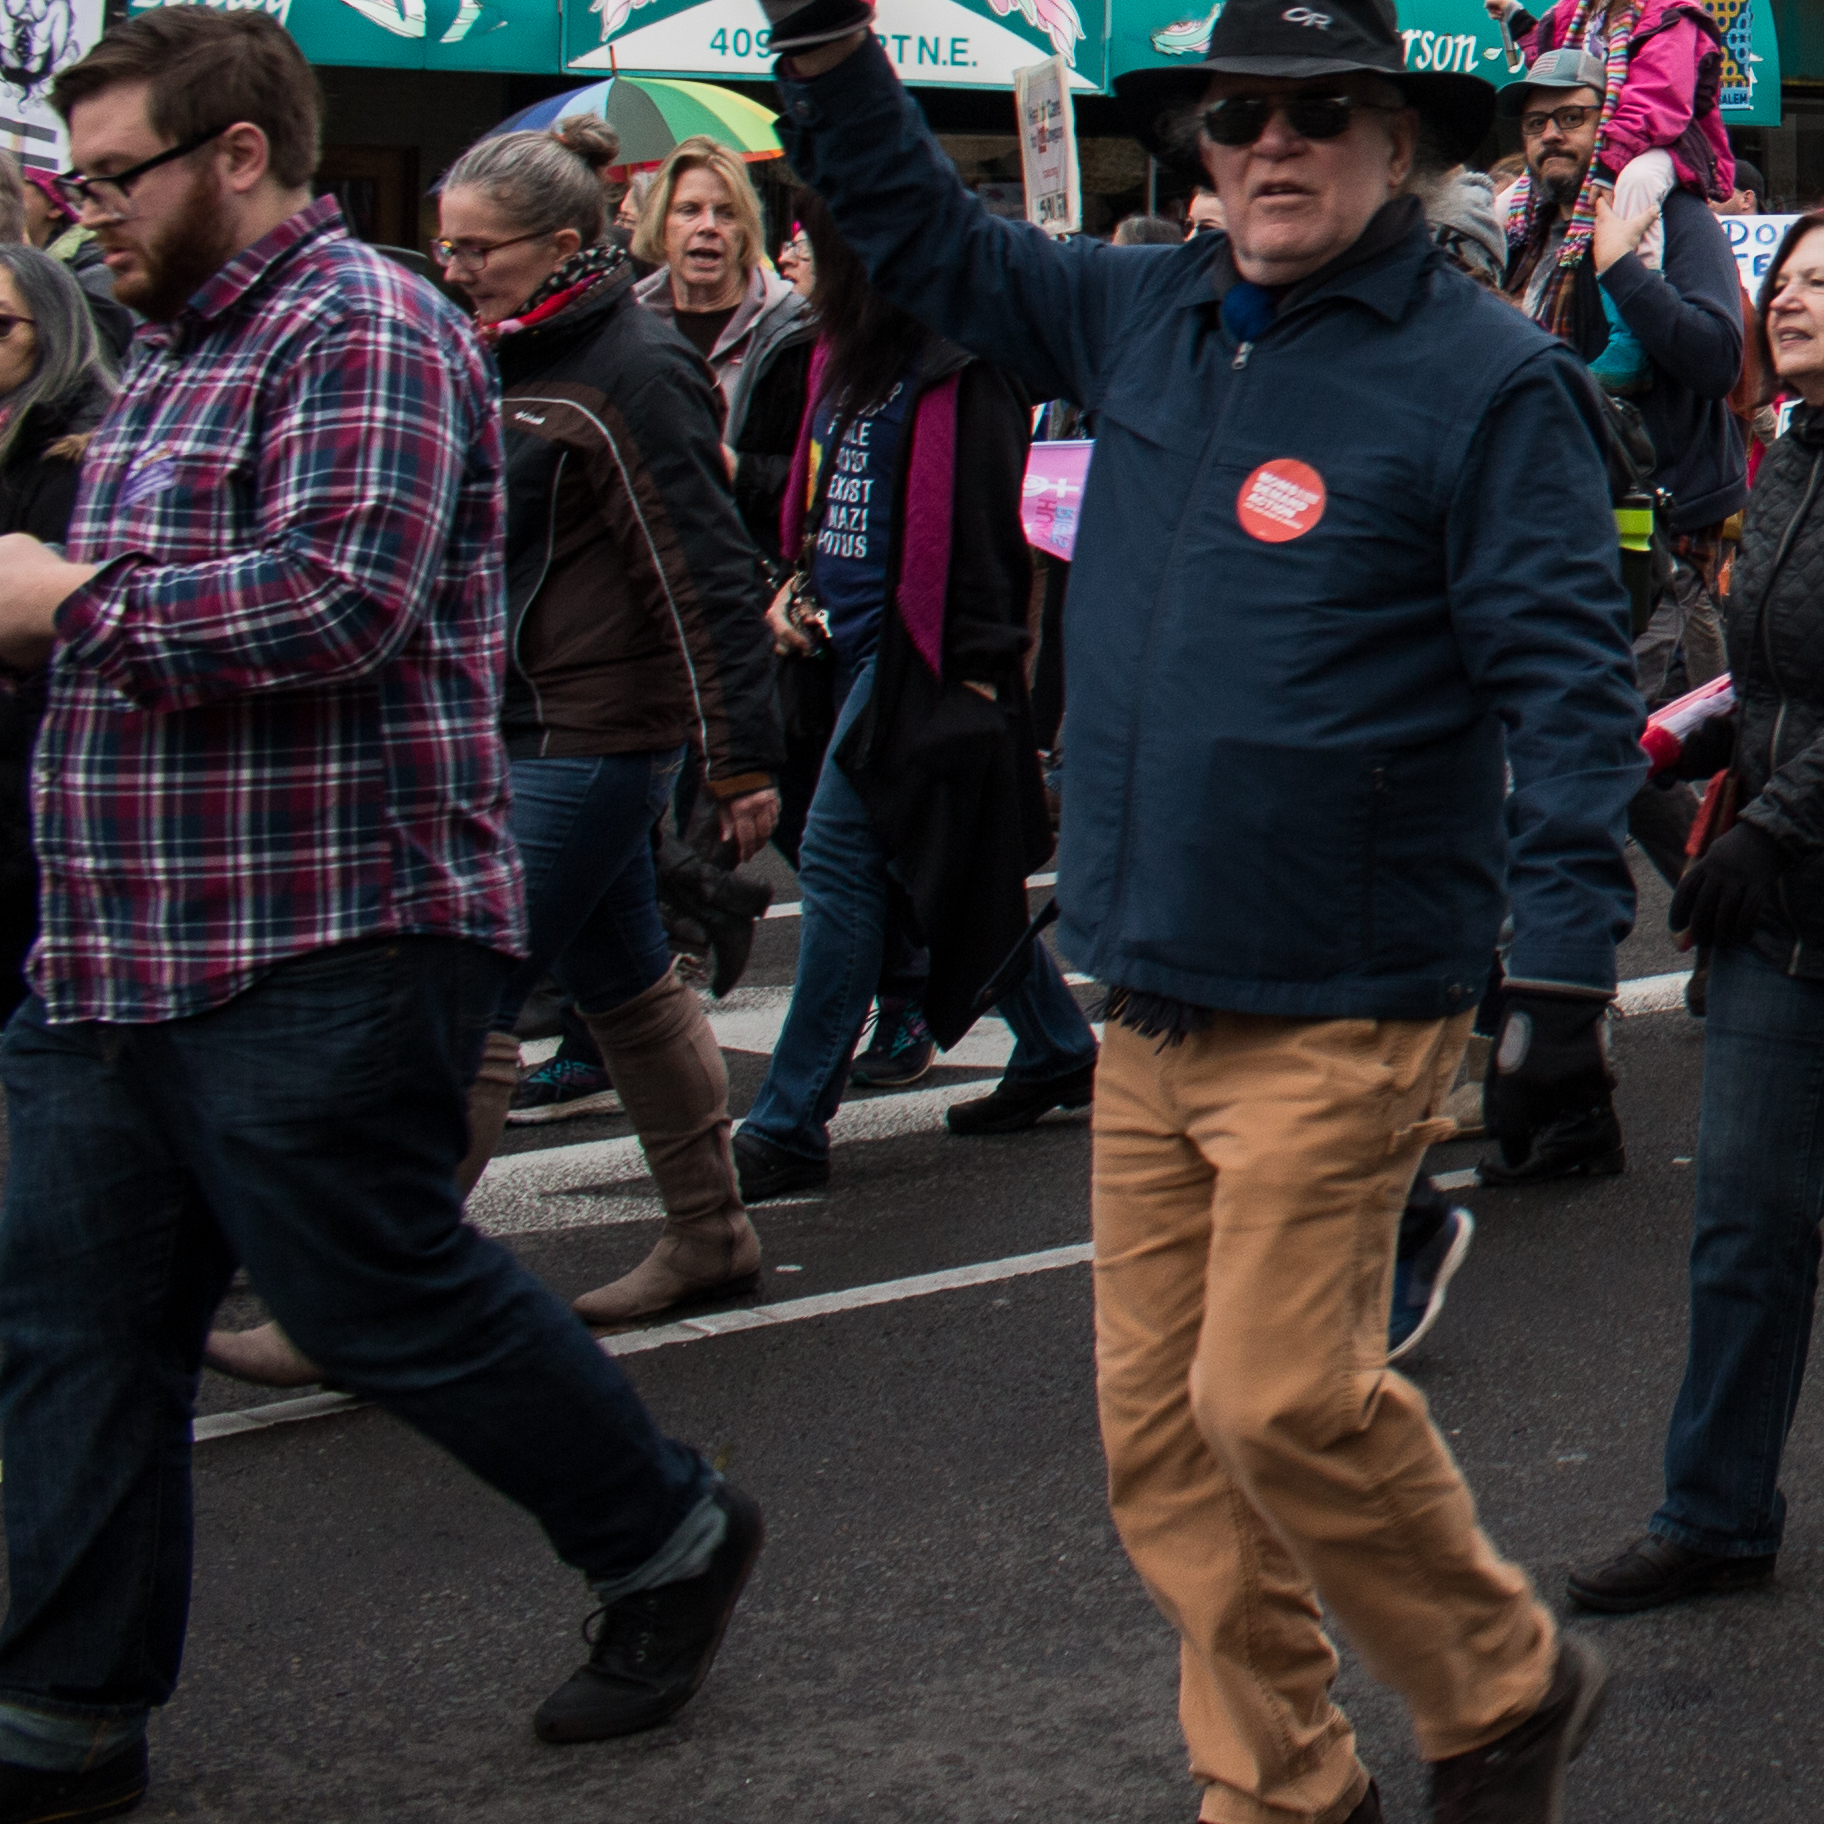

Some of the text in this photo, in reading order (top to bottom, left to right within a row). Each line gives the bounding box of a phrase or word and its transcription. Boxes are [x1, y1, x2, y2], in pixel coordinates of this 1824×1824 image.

[710, 28, 772, 58] 409
[918, 36, 978, 67] N.E.
[1402, 29, 1479, 72] rson
[1720, 93, 1748, 104] ALEM
[827, 473, 874, 503] EXIST
[828, 504, 868, 532] NAZI
